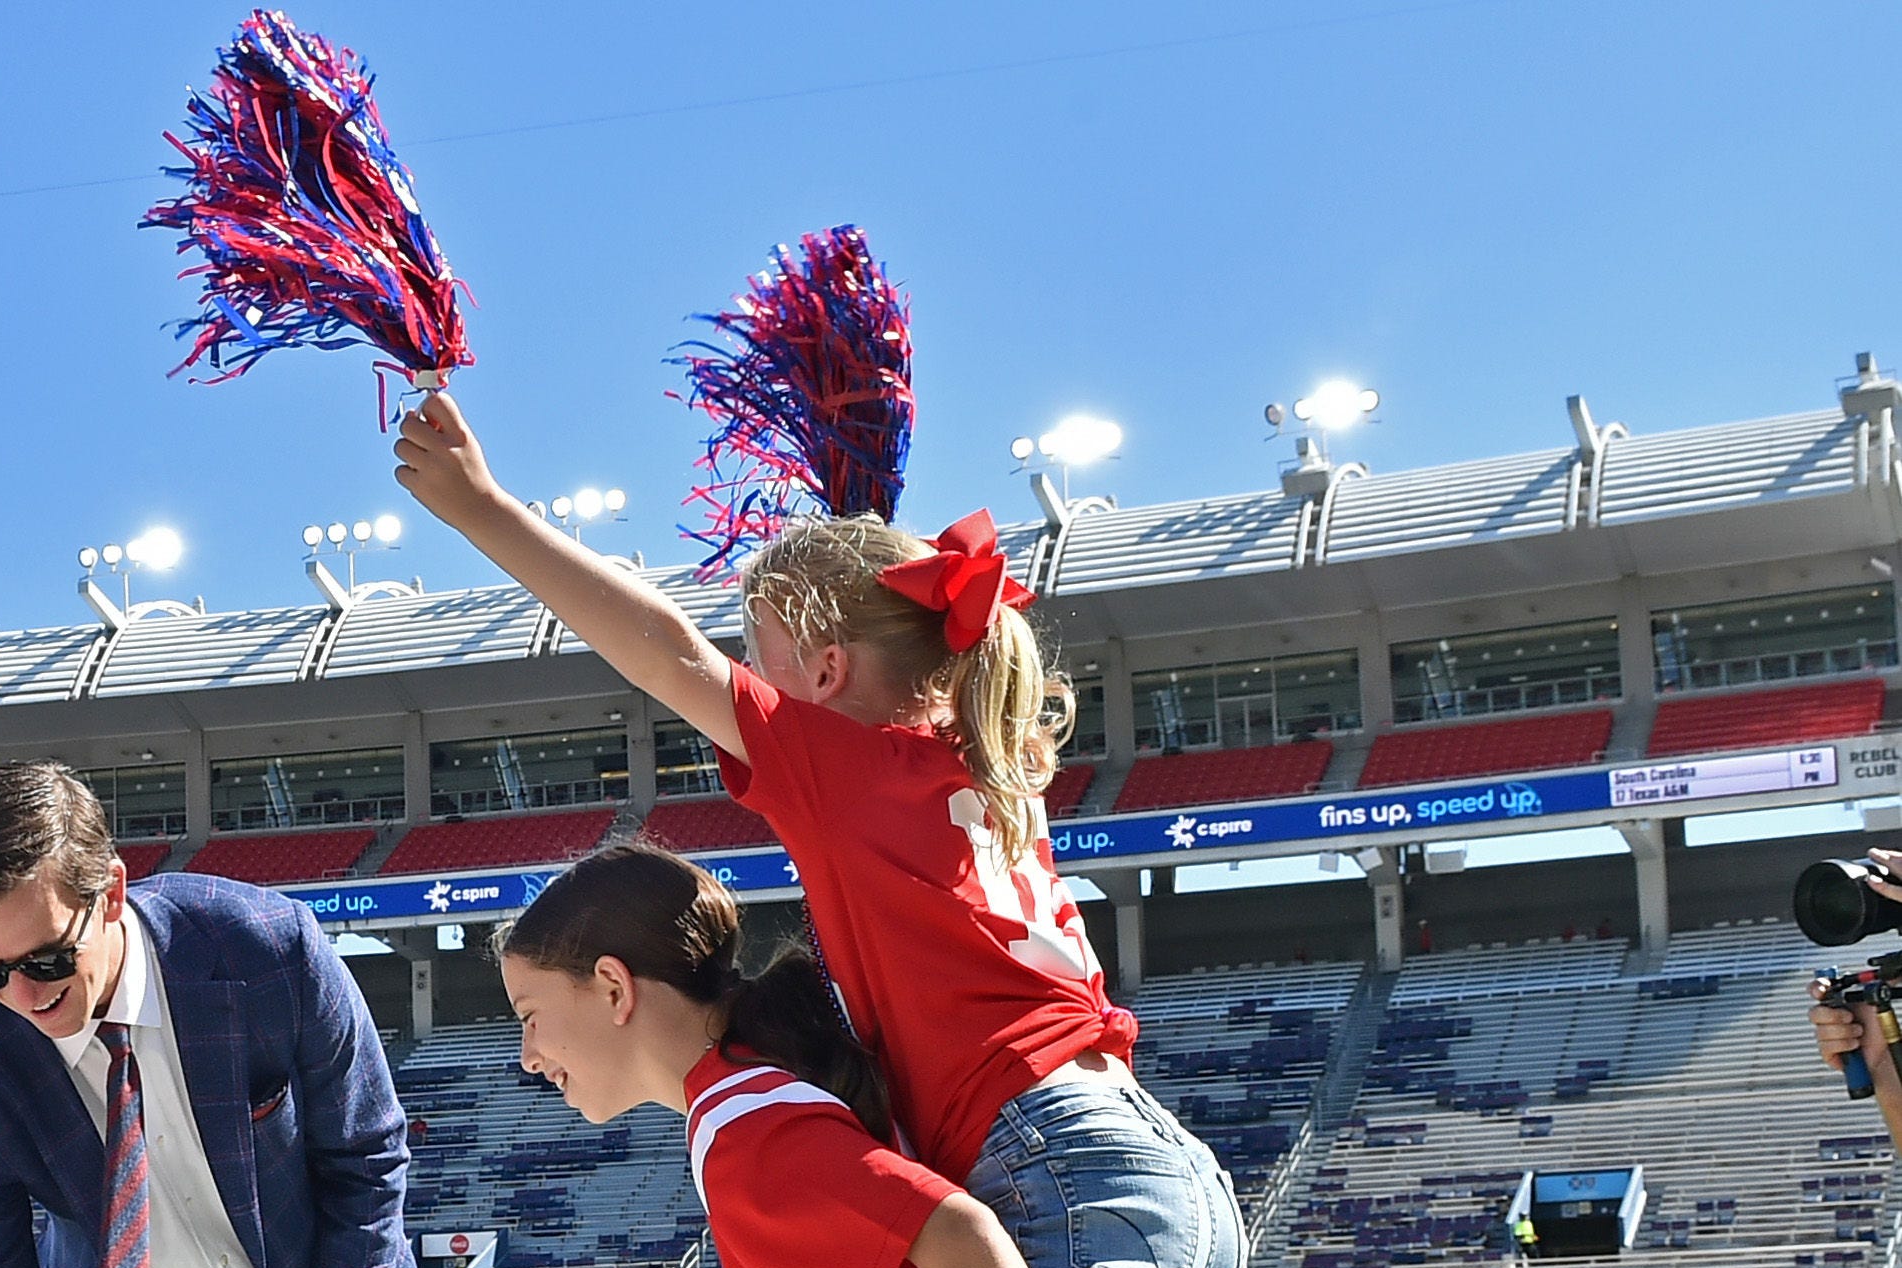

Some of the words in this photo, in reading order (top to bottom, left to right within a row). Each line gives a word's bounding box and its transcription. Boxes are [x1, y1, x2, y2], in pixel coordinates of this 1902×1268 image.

[1849, 748, 1900, 764] REBEL
[1615, 770, 1647, 785] South
[1650, 765, 1696, 781] Carolina
[1855, 764, 1897, 778] CLUB
[1629, 787, 1659, 801] Texas
[1663, 783, 1689, 797] A&M
[1319, 805, 1366, 828] fins
[1371, 803, 1412, 827] up,
[1417, 790, 1494, 822] speed
[1500, 790, 1542, 815] up.
[1077, 831, 1116, 853] up.
[345, 894, 379, 915] up.
